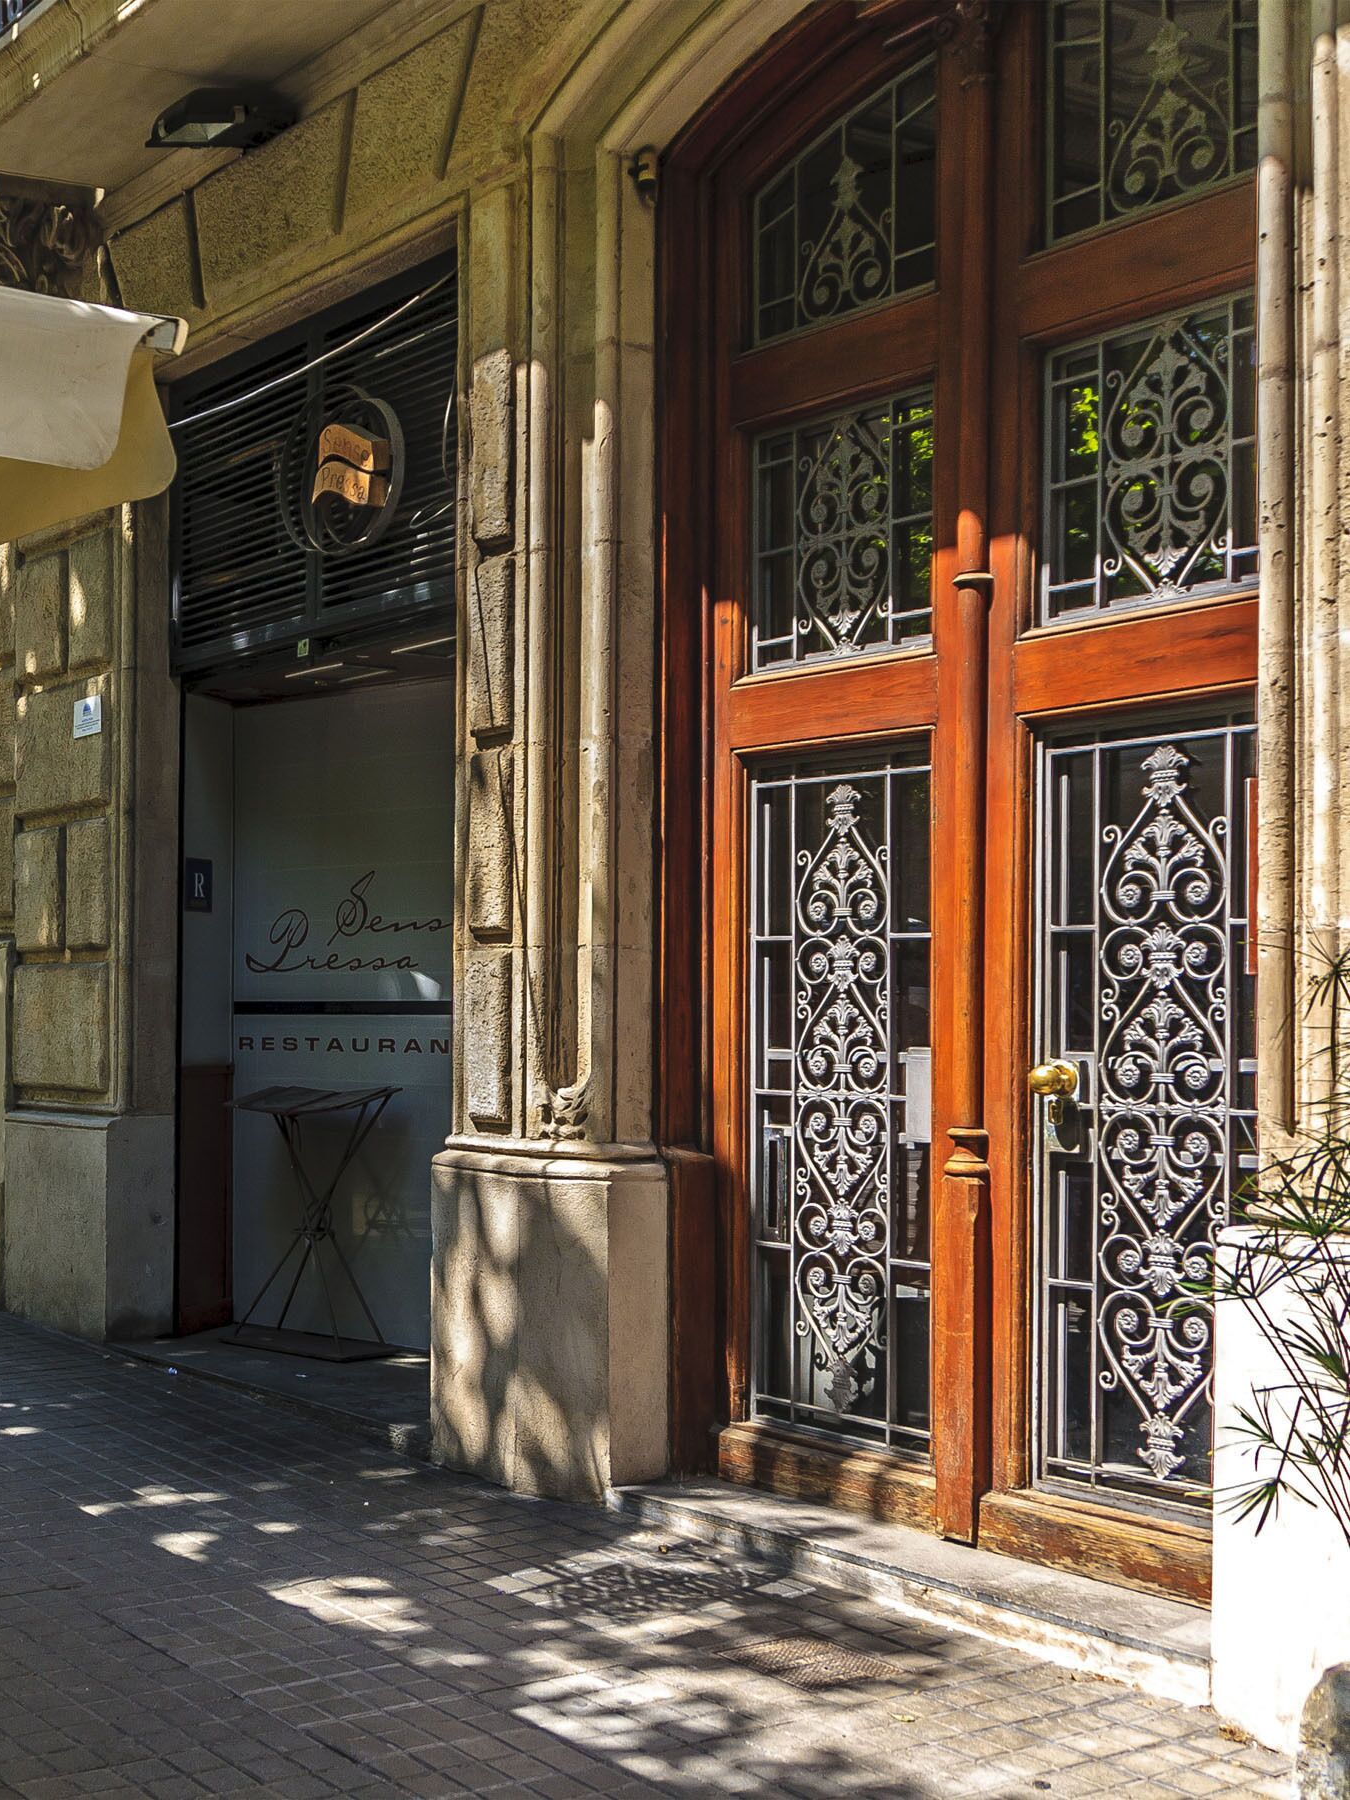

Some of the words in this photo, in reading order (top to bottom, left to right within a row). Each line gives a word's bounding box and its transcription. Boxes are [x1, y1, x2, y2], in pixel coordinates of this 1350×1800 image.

[323, 429, 370, 461] Sense
[321, 467, 366, 500] Pressa
[194, 872, 206, 897] R
[245, 908, 419, 973] Pressa
[239, 1036, 452, 1054] RESTAURAN
